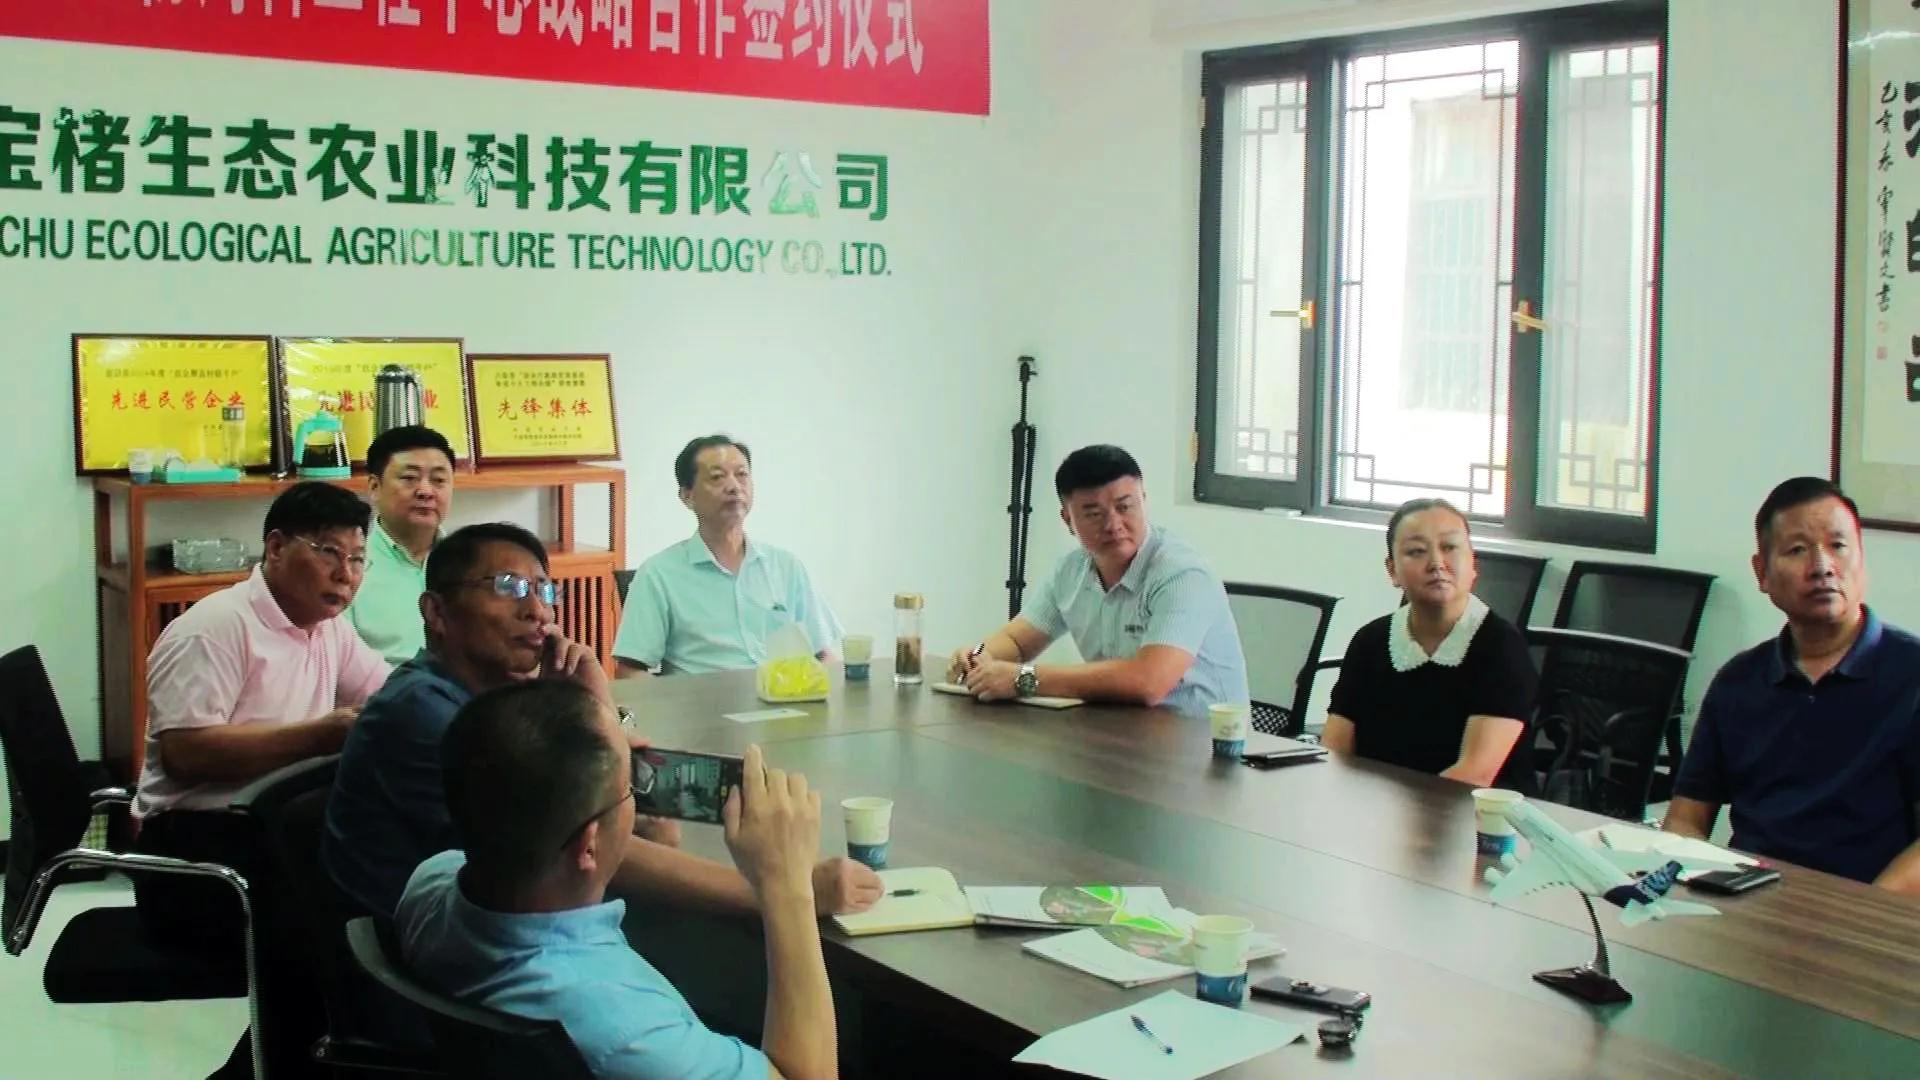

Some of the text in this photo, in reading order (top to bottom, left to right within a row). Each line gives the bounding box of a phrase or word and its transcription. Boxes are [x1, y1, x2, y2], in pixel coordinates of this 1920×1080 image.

[0, 215, 74, 259] CHU
[86, 219, 312, 263] ECOLOGICAL
[326, 227, 555, 268] AGRICULTURE
[567, 234, 774, 273] TECHNOLOGY
[112, 389, 245, 410] 先进民营企业
[498, 396, 592, 420] 先锋集体
